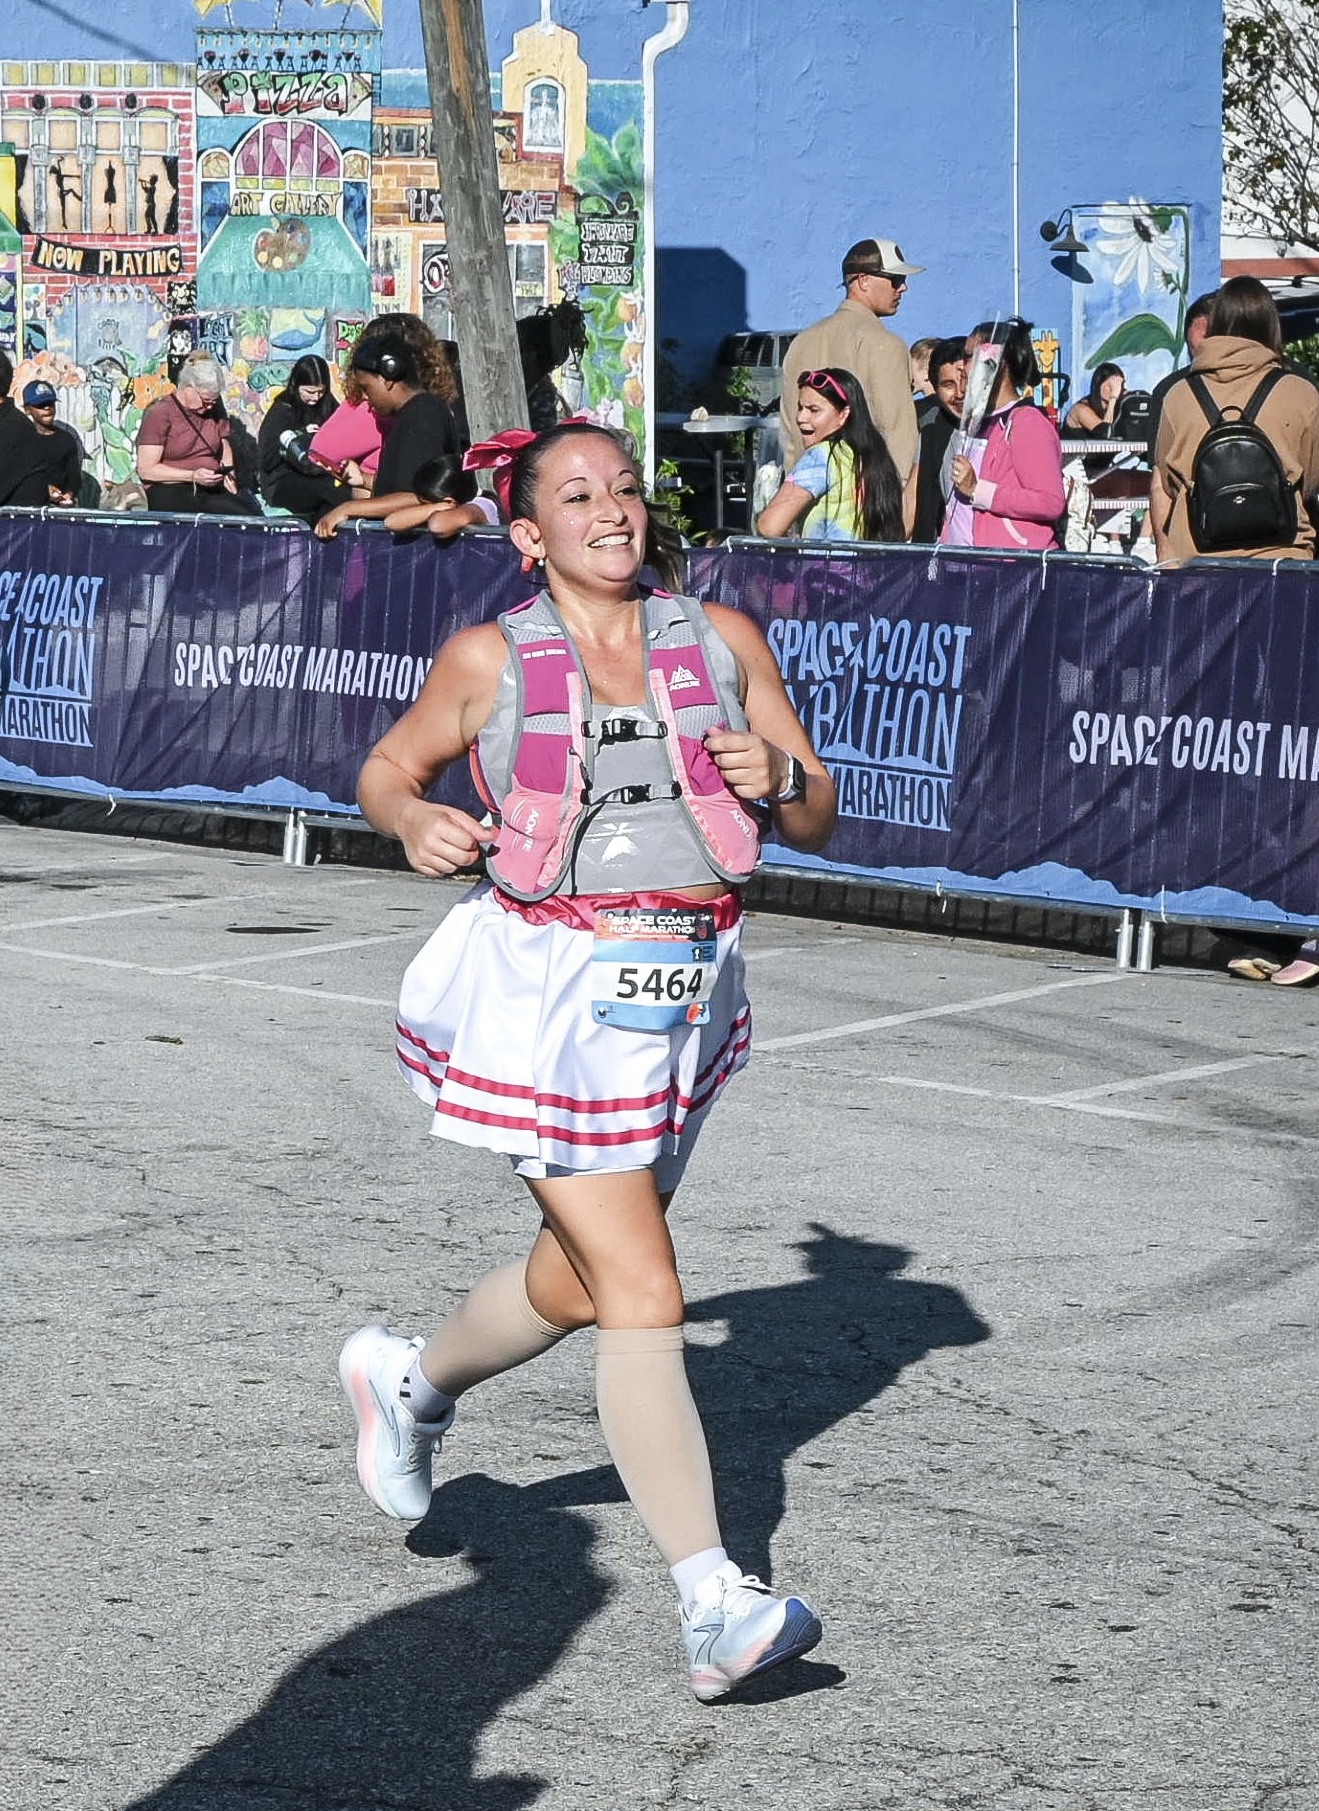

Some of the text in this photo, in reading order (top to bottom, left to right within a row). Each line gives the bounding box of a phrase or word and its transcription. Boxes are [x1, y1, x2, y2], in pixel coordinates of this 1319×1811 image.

[229, 191, 264, 216] ART
[37, 240, 180, 275] NOW PLAYING
[25, 572, 104, 629] COAST
[239, 642, 304, 689] COAST
[867, 617, 972, 688] COAST
[1172, 715, 1272, 776] COAST
[608, 924, 640, 934] HALF
[610, 914, 696, 926] SPACE COAST
[616, 968, 703, 1001] 5464
